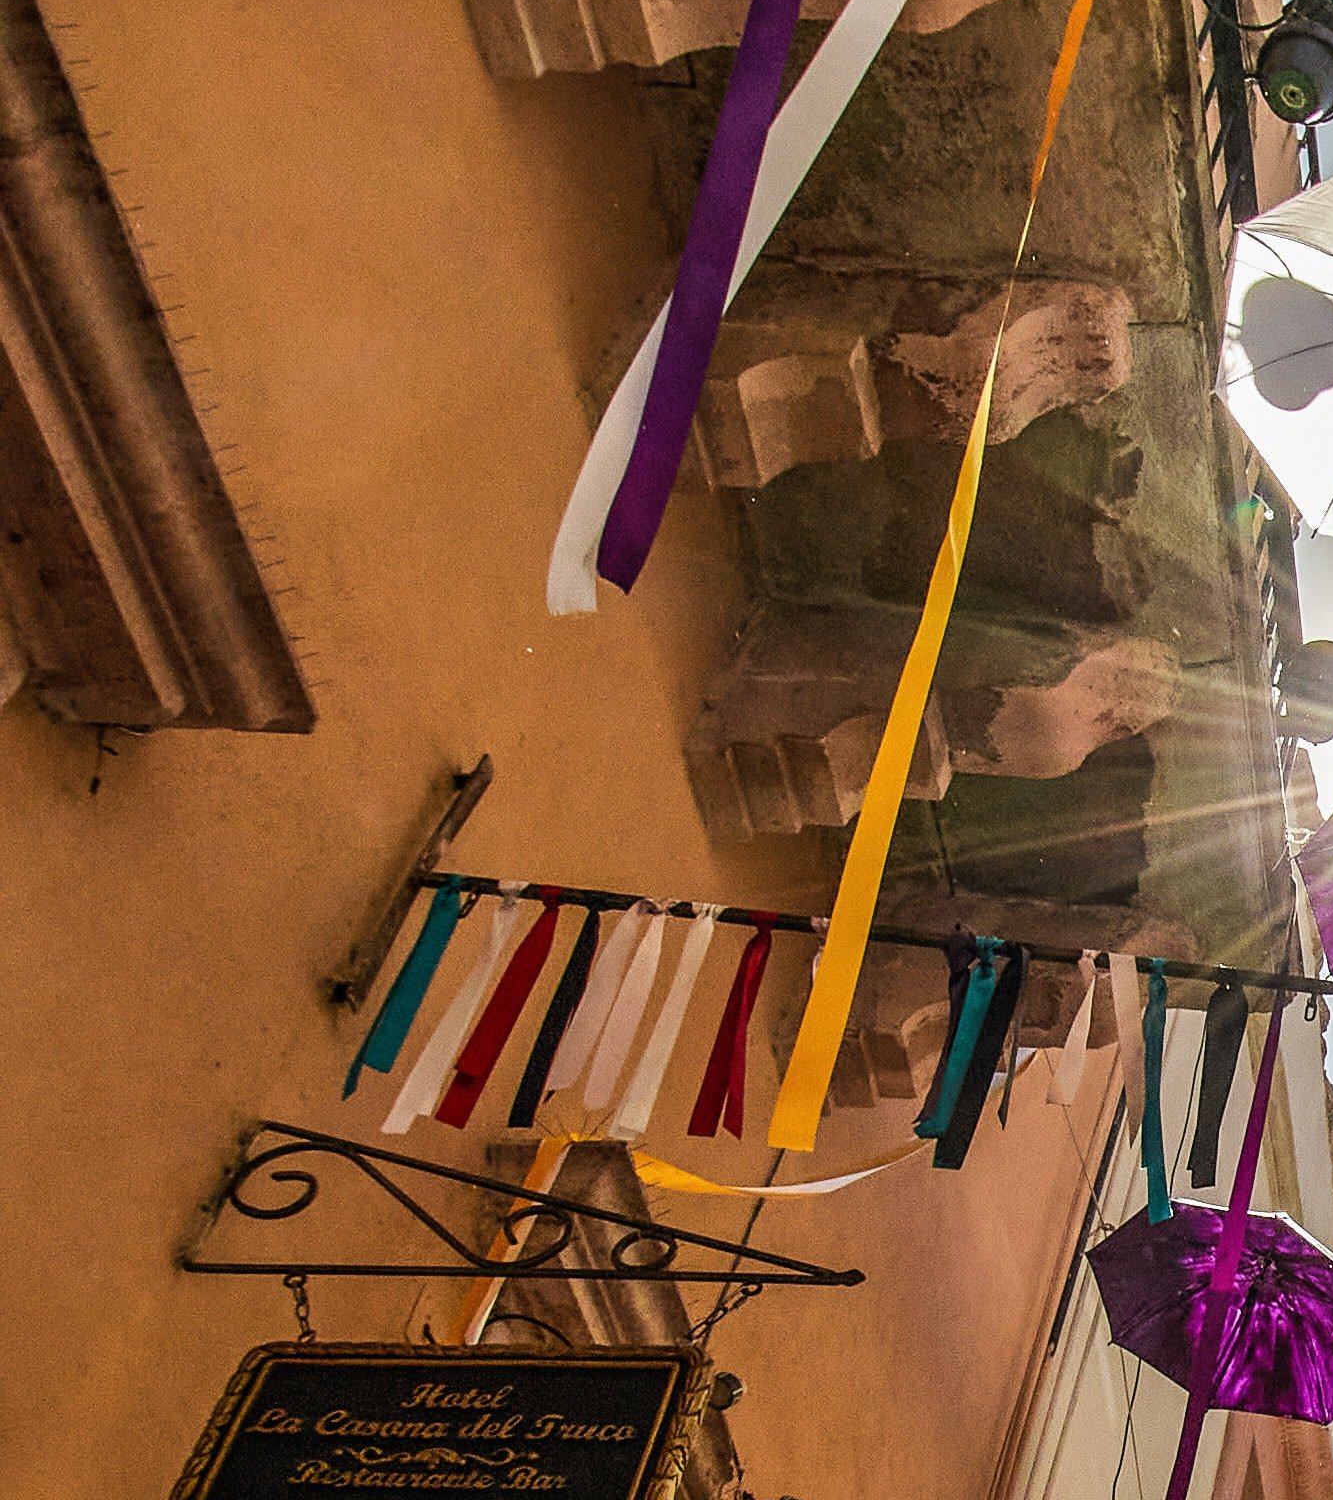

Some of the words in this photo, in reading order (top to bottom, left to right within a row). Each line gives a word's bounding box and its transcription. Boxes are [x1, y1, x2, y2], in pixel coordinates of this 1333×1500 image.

[400, 1382, 514, 1409] Hotel
[246, 1408, 302, 1434] La
[314, 1409, 450, 1439] Casona
[457, 1412, 523, 1440] del
[525, 1413, 635, 1441] Truco
[287, 1459, 496, 1490] Restaurante
[501, 1465, 568, 1491] Bar
